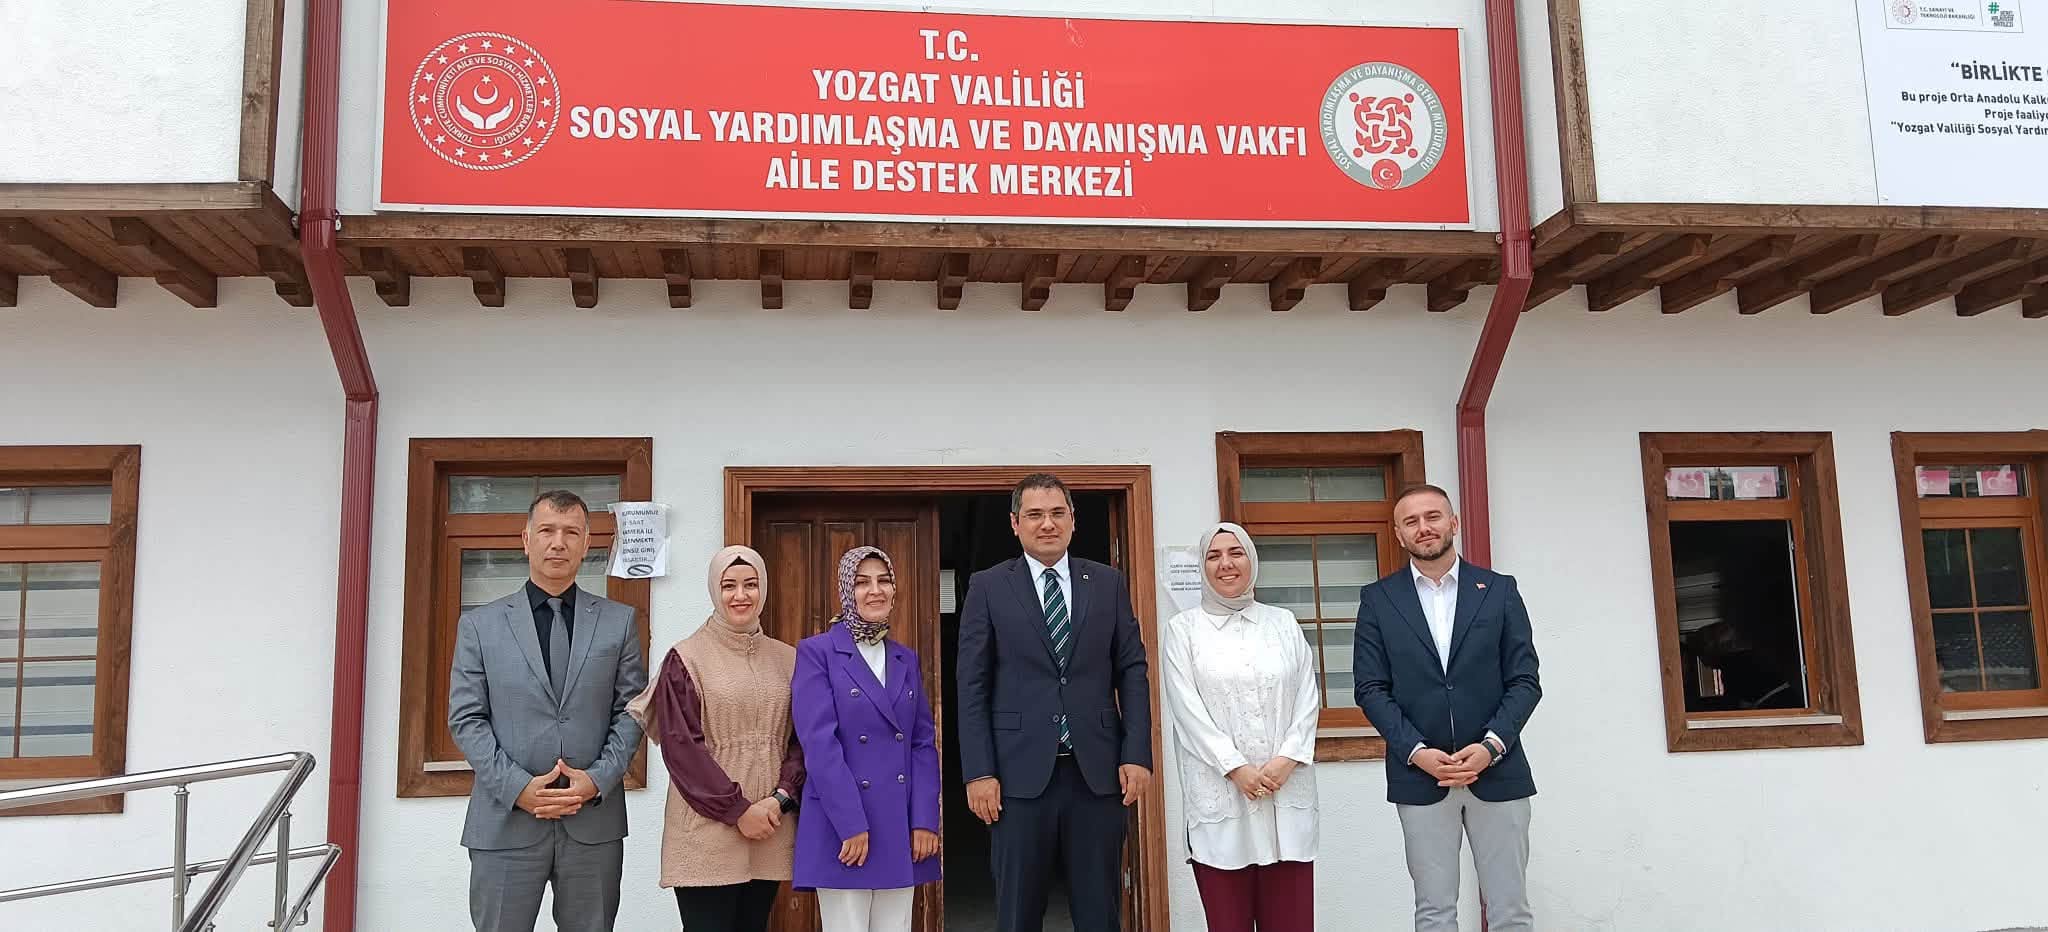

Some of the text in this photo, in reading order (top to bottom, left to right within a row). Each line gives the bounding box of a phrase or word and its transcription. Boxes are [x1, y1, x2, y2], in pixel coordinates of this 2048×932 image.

[919, 29, 979, 62] T.C.
[474, 56, 486, 65] VE
[487, 56, 517, 73] SOSYAL
[812, 69, 1085, 109] YOZGAT VALİLİĞİ
[1901, 91, 2048, 105] Bu proje Orta Anadolu Kalk
[1327, 138, 1352, 170] SOSYAL
[1350, 69, 1363, 80] VE
[1936, 122, 1975, 136] Valiliği
[1977, 123, 2013, 136] Sosyal
[1984, 108, 2013, 121] Proje
[569, 106, 1307, 162] SOSYAL YARDIMLAŞMA VE DAYANIŞMA VAKFI
[765, 150, 1133, 197] AİLE DESTEK MERKEZİ
